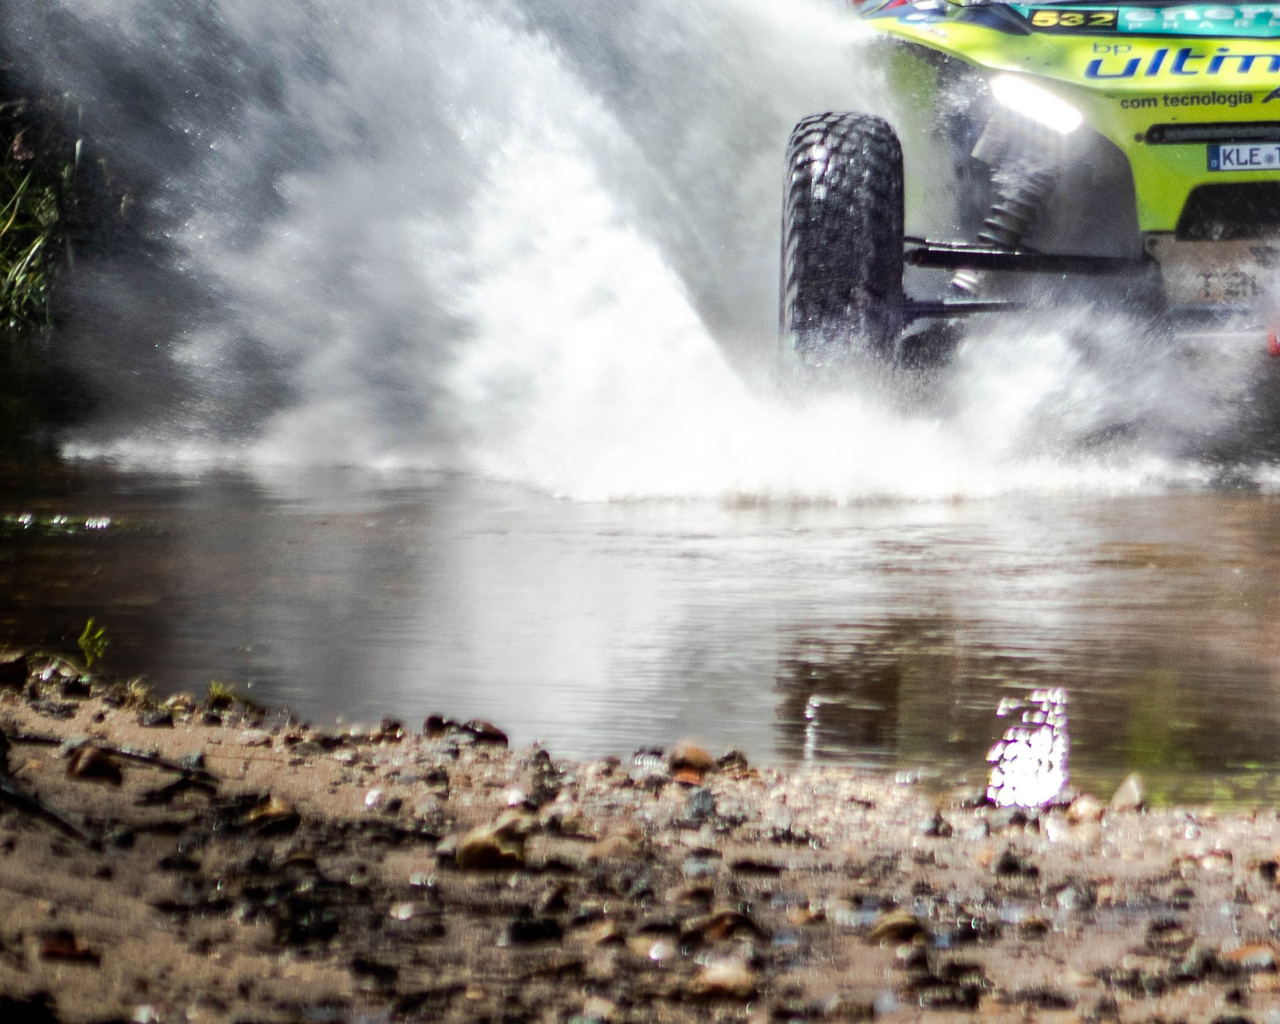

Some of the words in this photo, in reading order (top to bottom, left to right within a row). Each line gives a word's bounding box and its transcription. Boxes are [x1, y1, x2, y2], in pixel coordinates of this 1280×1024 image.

[1031, 10, 1116, 27] 532
[1092, 42, 1132, 56] bp
[1120, 96, 1158, 109] com
[1163, 90, 1253, 108] tecnologia
[1222, 147, 1261, 166] KLE
